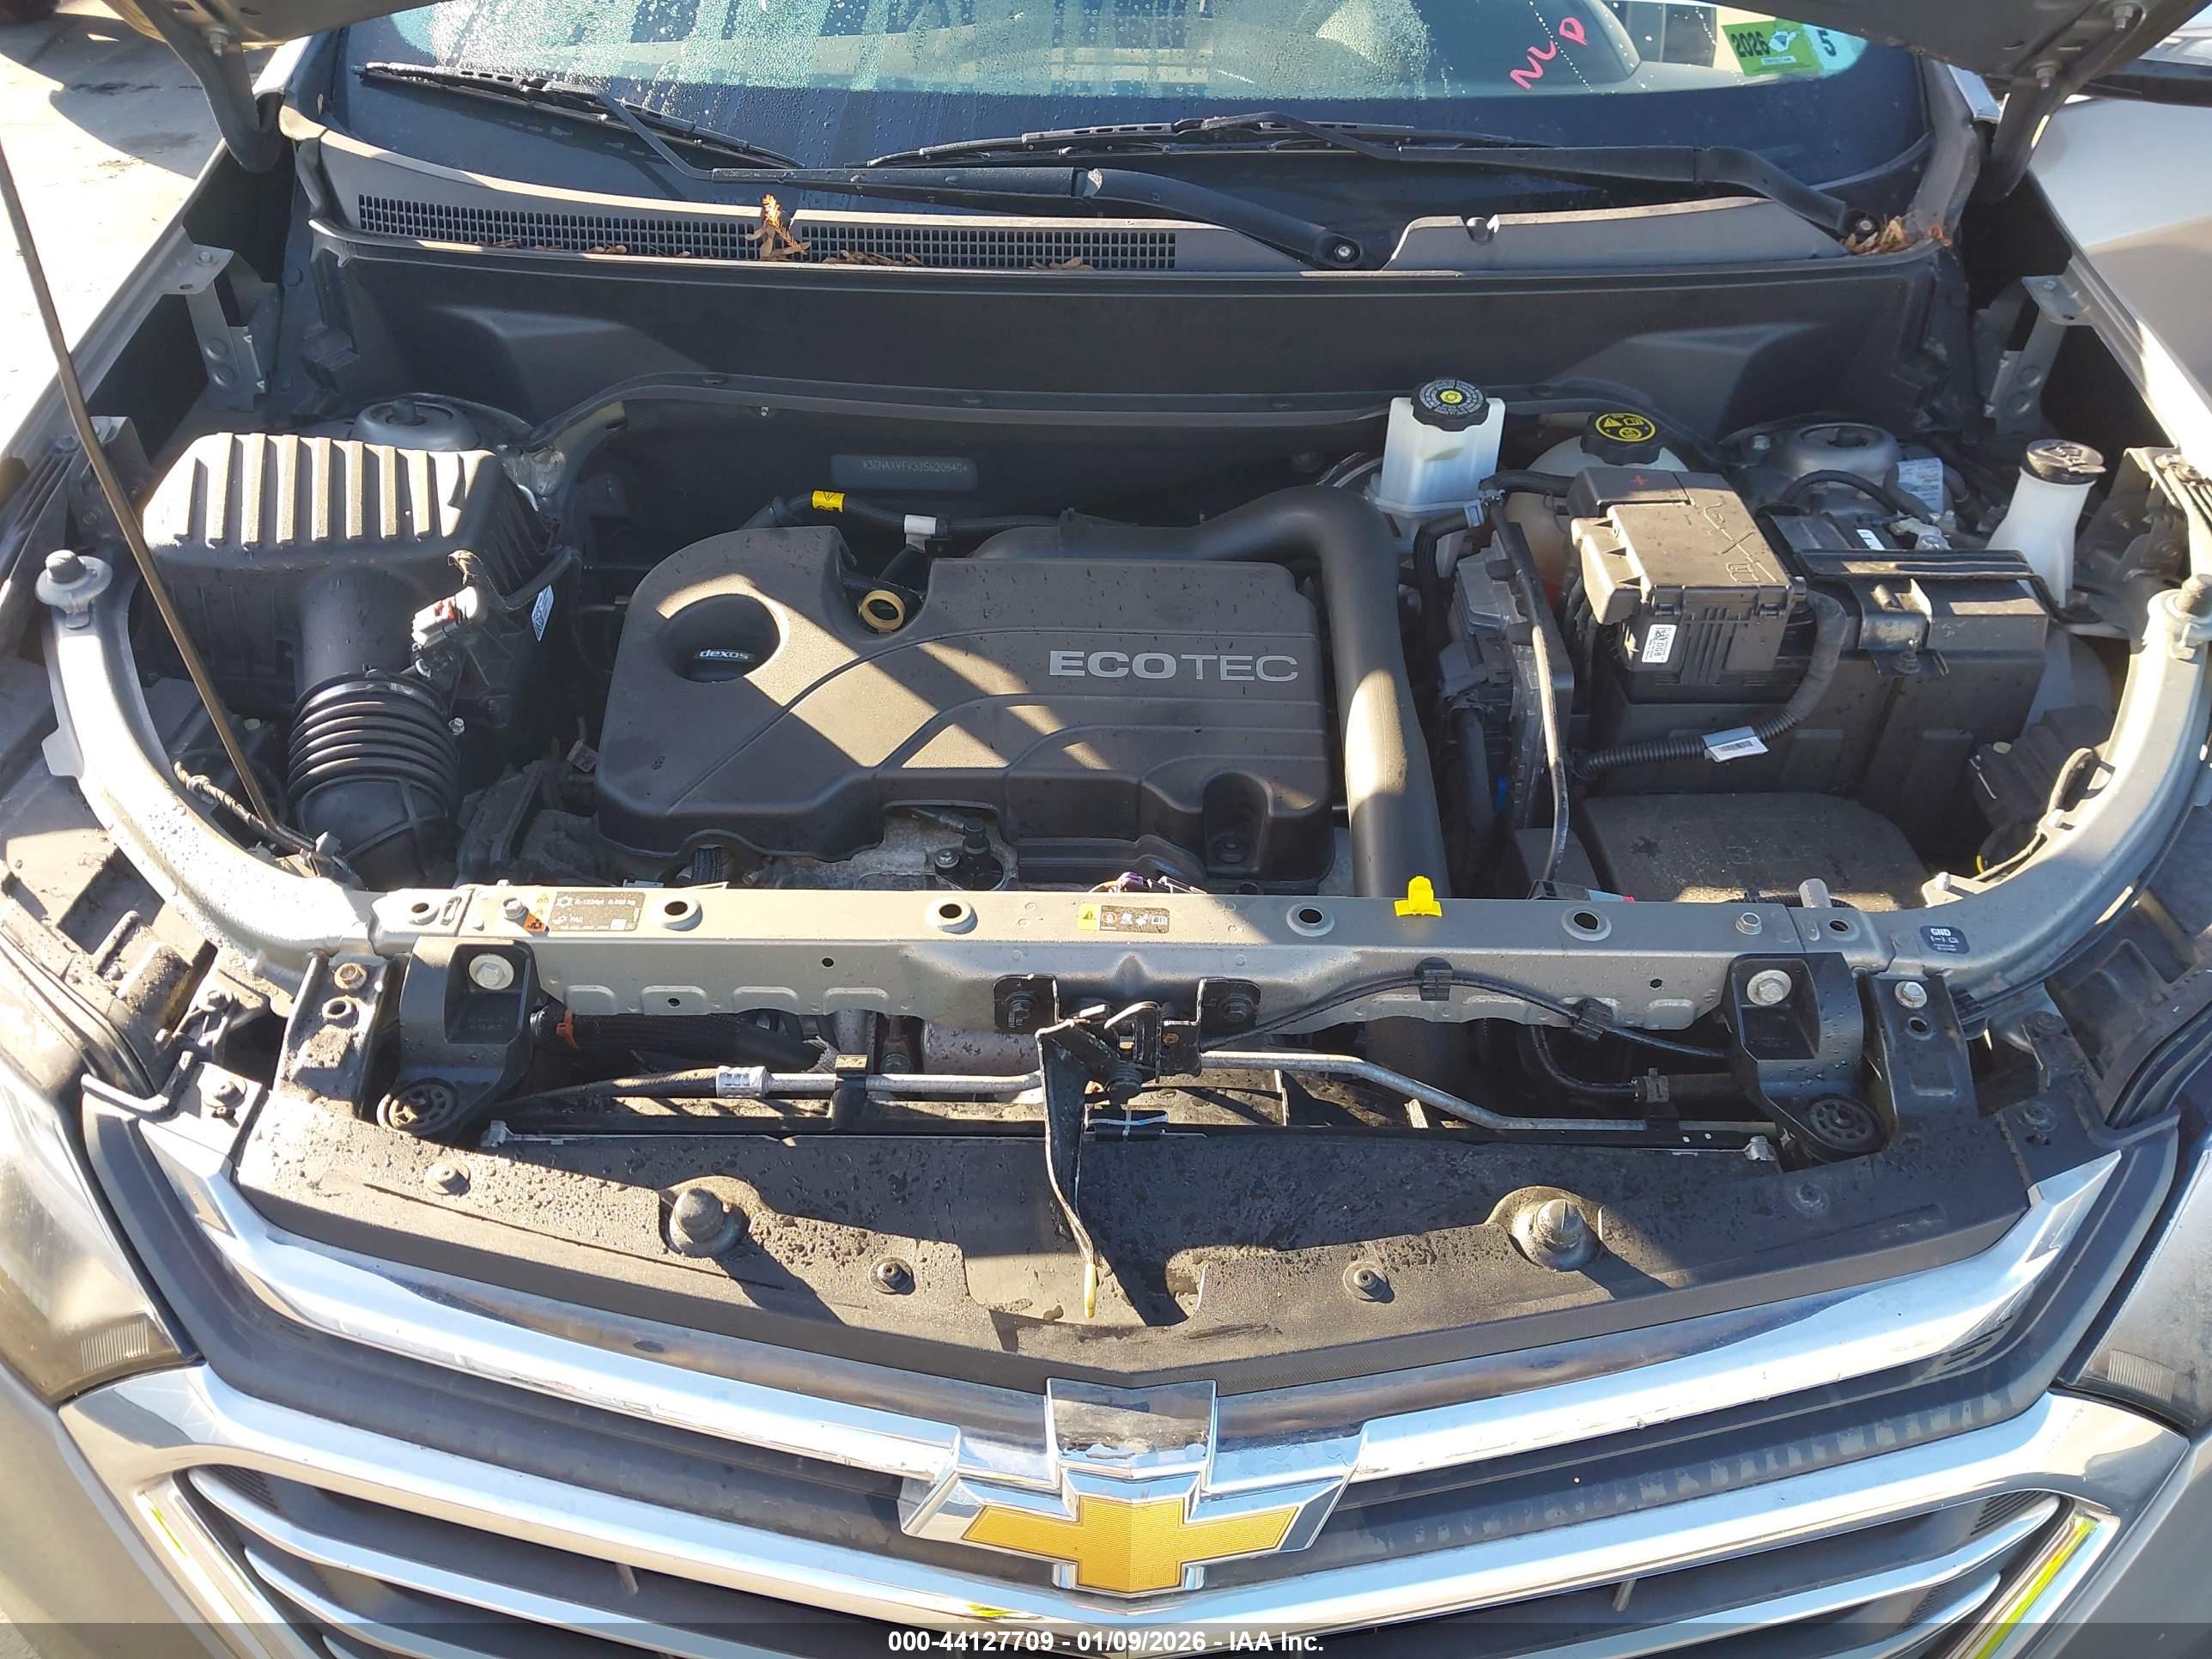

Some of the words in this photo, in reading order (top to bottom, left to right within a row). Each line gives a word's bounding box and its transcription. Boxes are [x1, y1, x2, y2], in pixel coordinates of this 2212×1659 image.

[1730, 31, 1771, 58] 2026
[1816, 29, 1838, 57] 5
[699, 649, 750, 659] dexos
[1049, 650, 1298, 682] ECOTEC
[1929, 927, 1952, 936] GND
